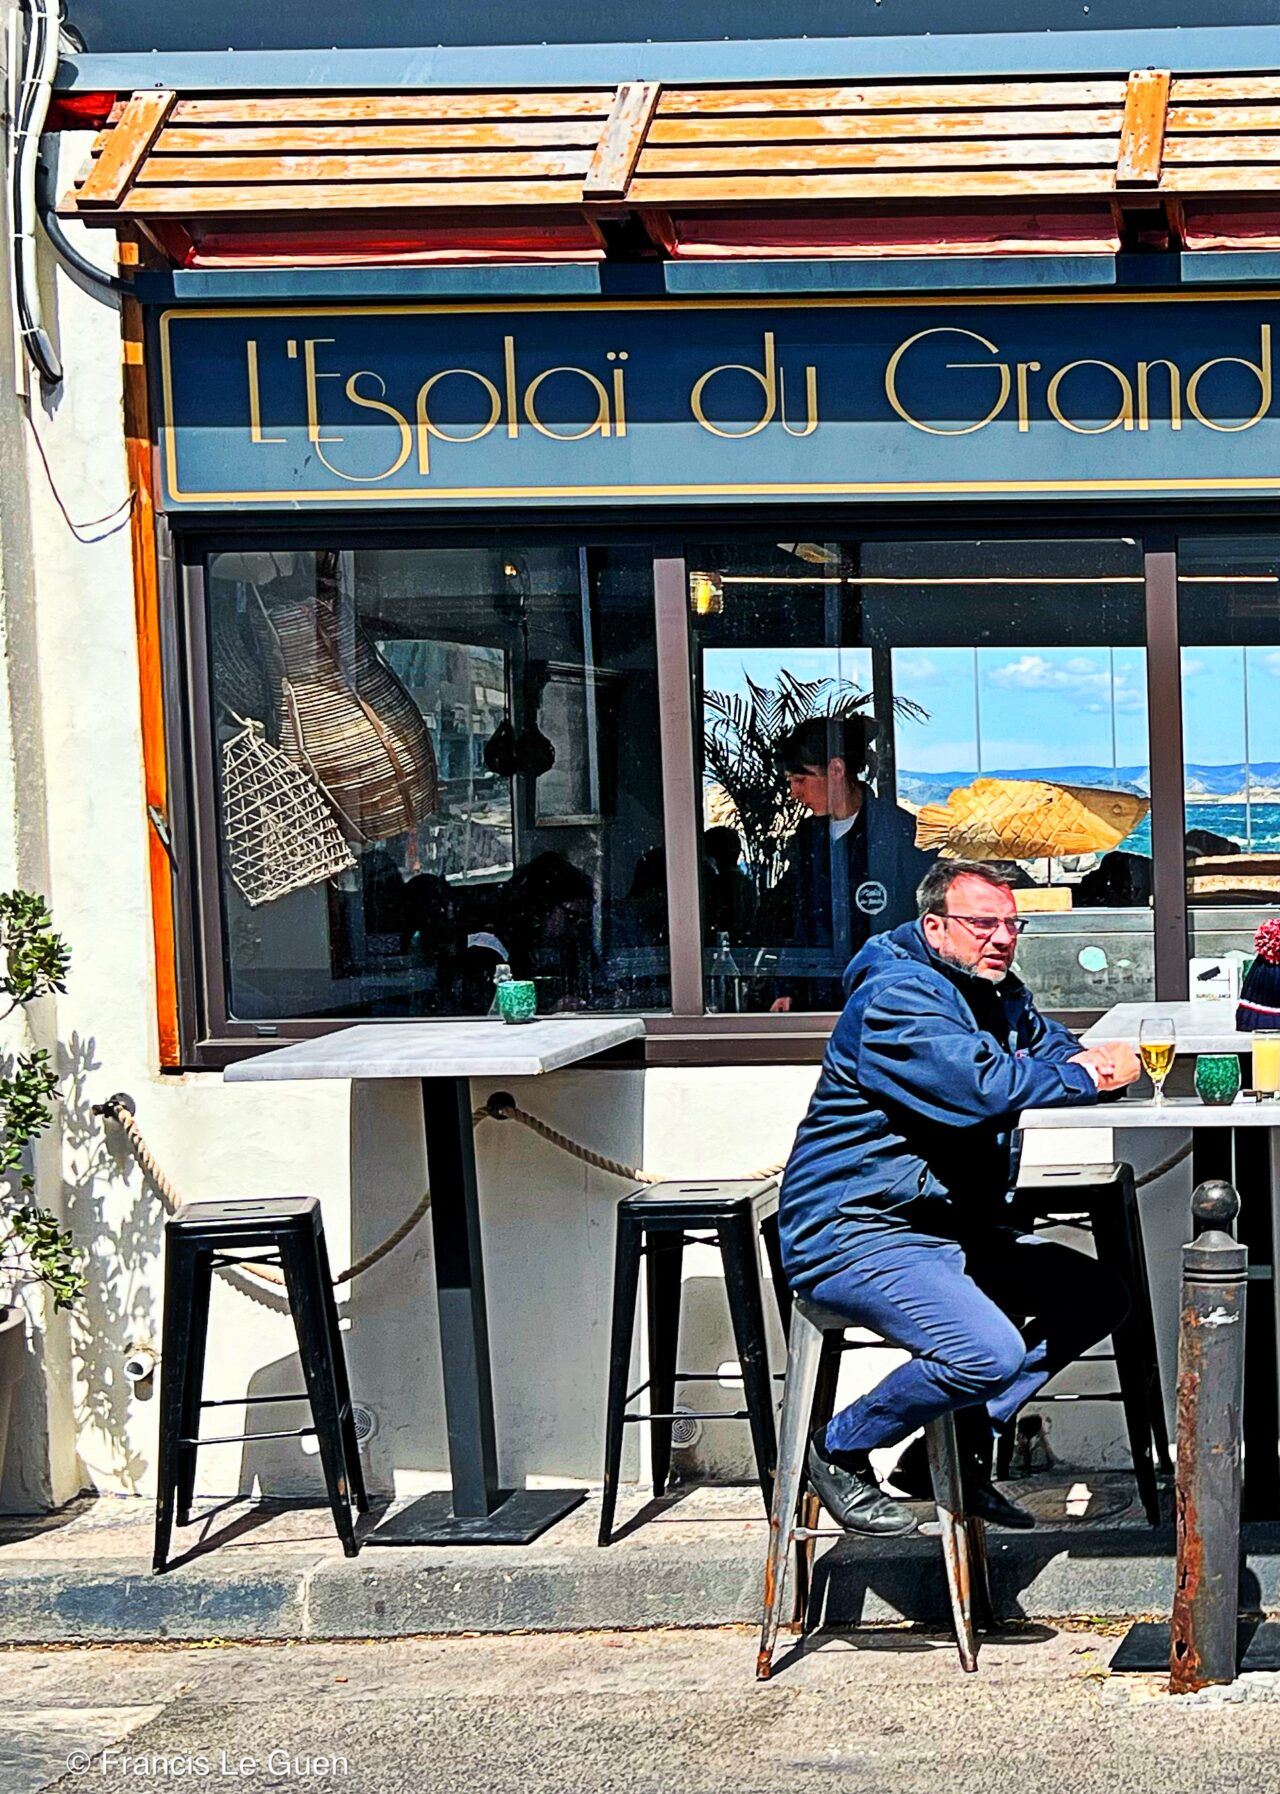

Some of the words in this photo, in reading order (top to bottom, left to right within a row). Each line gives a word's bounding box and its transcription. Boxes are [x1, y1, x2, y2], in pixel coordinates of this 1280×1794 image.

[246, 335, 629, 481] L'Esplaï
[690, 331, 817, 438] du
[885, 323, 1273, 436] Grand
